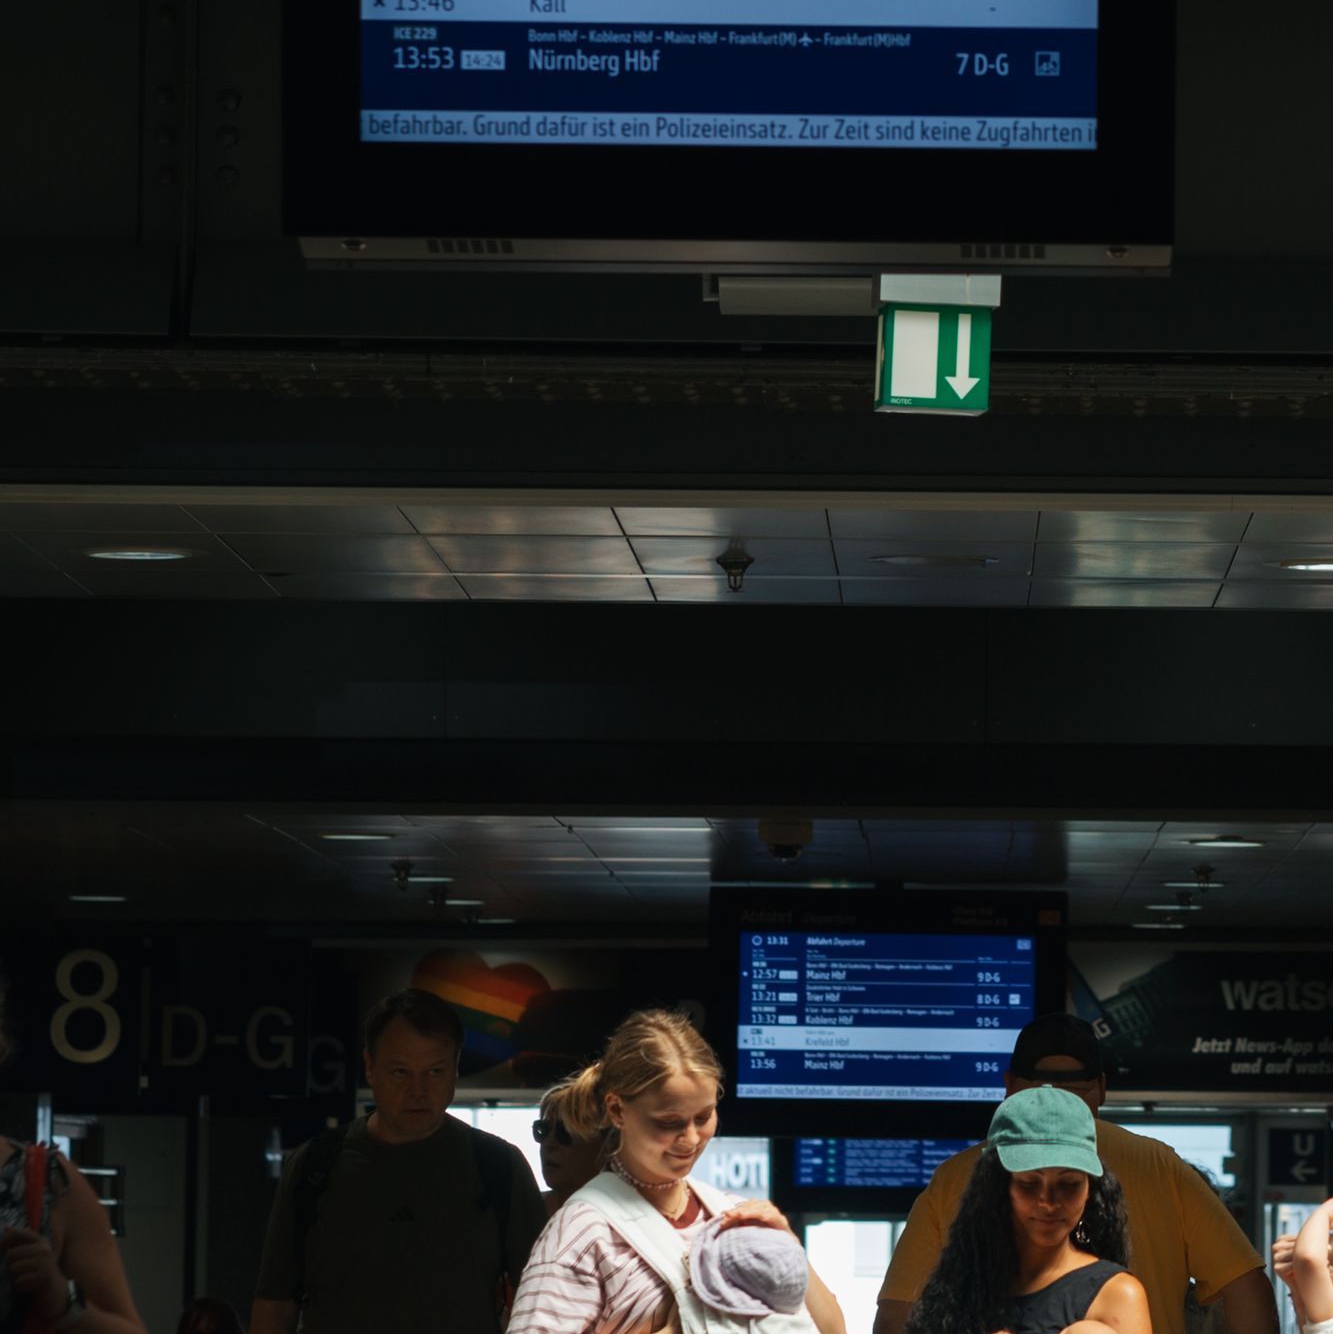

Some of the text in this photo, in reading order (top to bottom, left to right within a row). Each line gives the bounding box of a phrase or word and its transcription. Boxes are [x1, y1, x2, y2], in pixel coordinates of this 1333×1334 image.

[528, 29, 556, 42] Bonn
[558, 29, 578, 42] Hbf
[589, 30, 631, 44] Koblenz
[634, 30, 654, 44] Hbf
[664, 31, 696, 45] Mainz
[698, 31, 718, 45] Hbf
[394, 47, 455, 69] 13:53
[529, 49, 661, 77] Nürnberg Hbf
[956, 53, 1009, 76] 7 D-G
[368, 114, 468, 137] befahrbar.
[473, 115, 531, 137] Grund
[536, 115, 588, 138] dafür
[592, 117, 615, 138] ist
[621, 117, 650, 138] ein
[656, 117, 792, 141] Polizeieinsatz.
[798, 118, 828, 140] Zur
[834, 118, 869, 141] Zeit
[875, 119, 914, 142] sind
[920, 119, 971, 143] keine
[976, 119, 1082, 146] Zugfahrten
[49, 948, 121, 1064] 8
[161, 1004, 295, 1069] D-G
[1192, 1036, 1232, 1053] Jetzt
[1230, 1058, 1262, 1074] und
[1293, 1132, 1316, 1157] U
